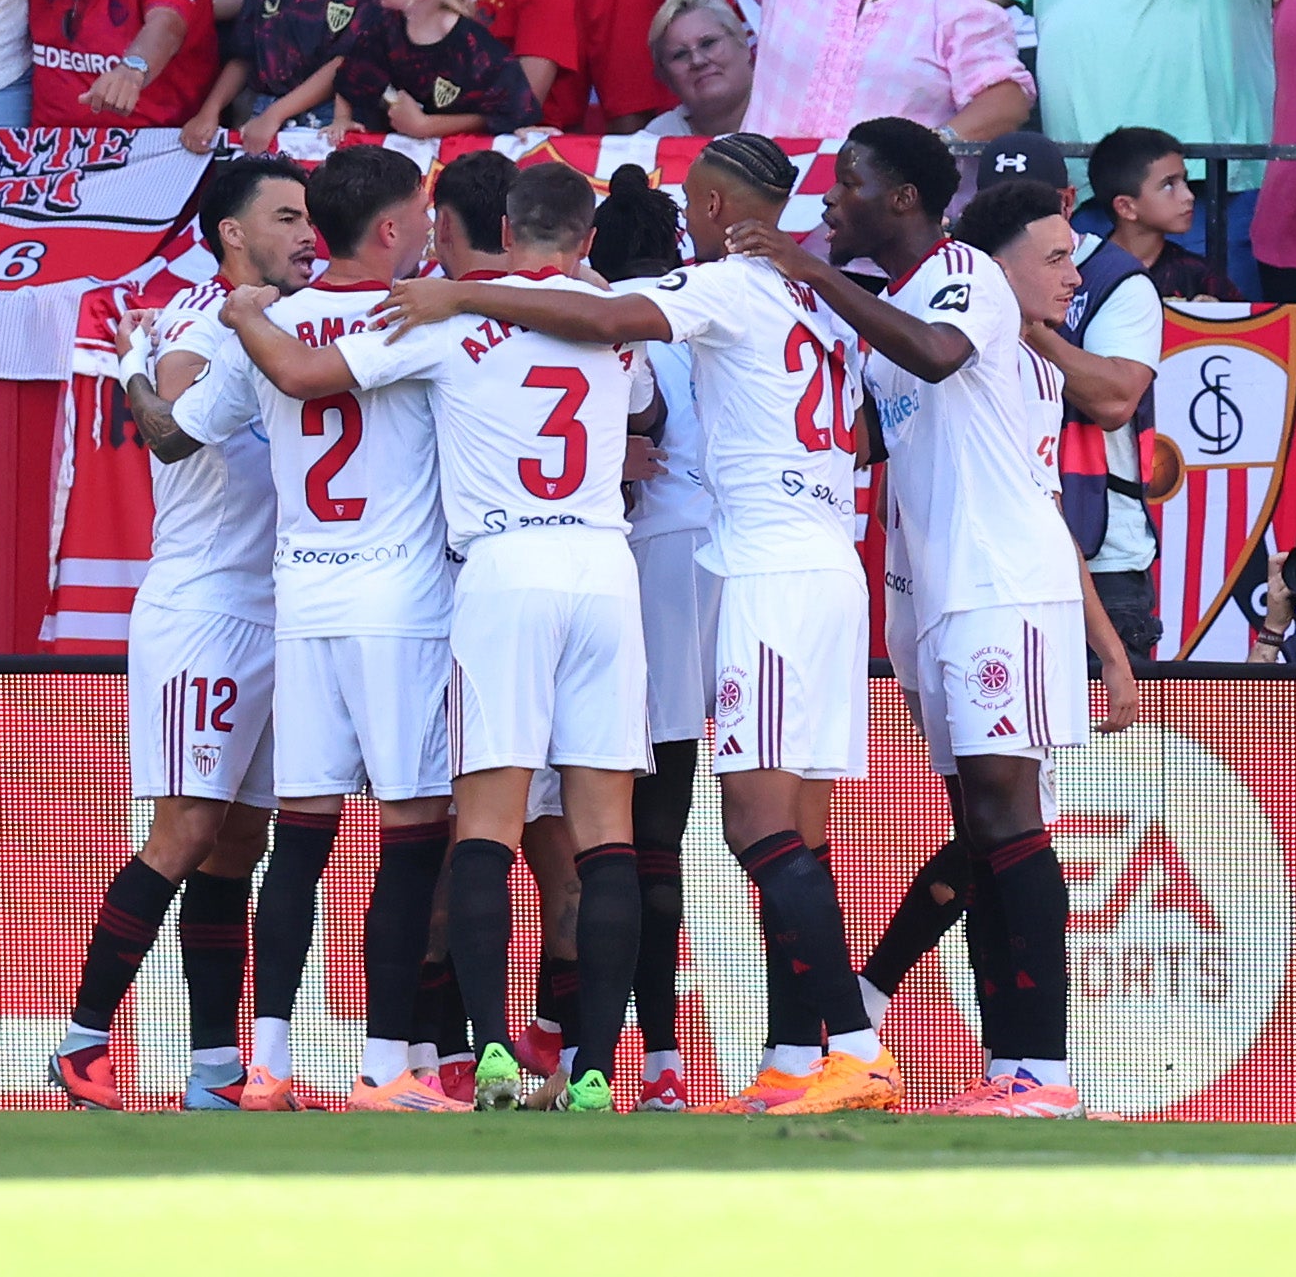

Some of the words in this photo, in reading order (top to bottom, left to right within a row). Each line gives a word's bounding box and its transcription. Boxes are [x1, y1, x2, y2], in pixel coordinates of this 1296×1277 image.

[301, 391, 367, 523] 2
[517, 365, 590, 501] 3
[970, 647, 992, 663] JUICE
[994, 646, 1014, 660] TIME
[189, 676, 238, 733] 12
